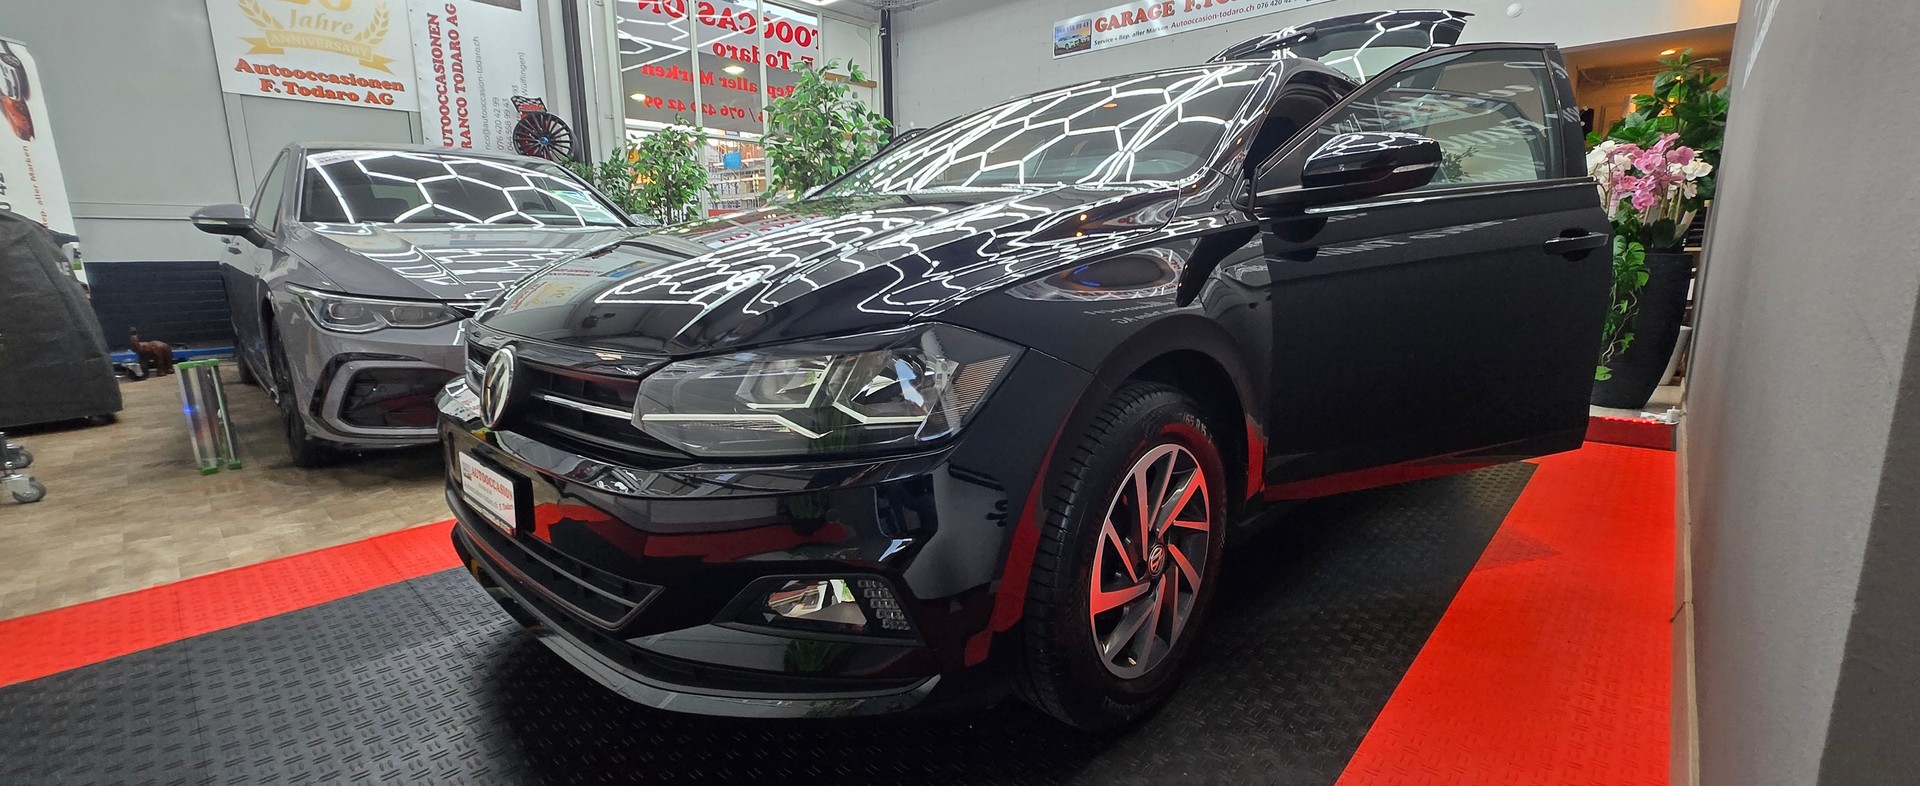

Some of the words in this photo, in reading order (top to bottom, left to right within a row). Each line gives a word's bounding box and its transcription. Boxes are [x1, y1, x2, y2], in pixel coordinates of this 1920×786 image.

[289, 9, 354, 34] Jahre
[445, 3, 458, 27] AG
[1095, 1, 1175, 33] GARAGE
[1171, 4, 1255, 29] Autooccasion-todaro.ch
[270, 33, 369, 57] ANNIVERSARY
[448, 29, 466, 94] TODARO
[234, 58, 405, 92] Autooccasionen
[427, 12, 454, 147] UTOOCCASIONEN
[259, 78, 281, 93] F.
[282, 81, 359, 102] Todaro
[364, 91, 395, 106] AG
[473, 36, 491, 150] nco@autooccasion-todaro.ch
[492, 97, 500, 107] 99
[455, 97, 472, 149] RANCO
[494, 107, 501, 118] 42
[495, 119, 503, 134] 420
[22, 145, 37, 182] Marken
[33, 184, 43, 206] aller
